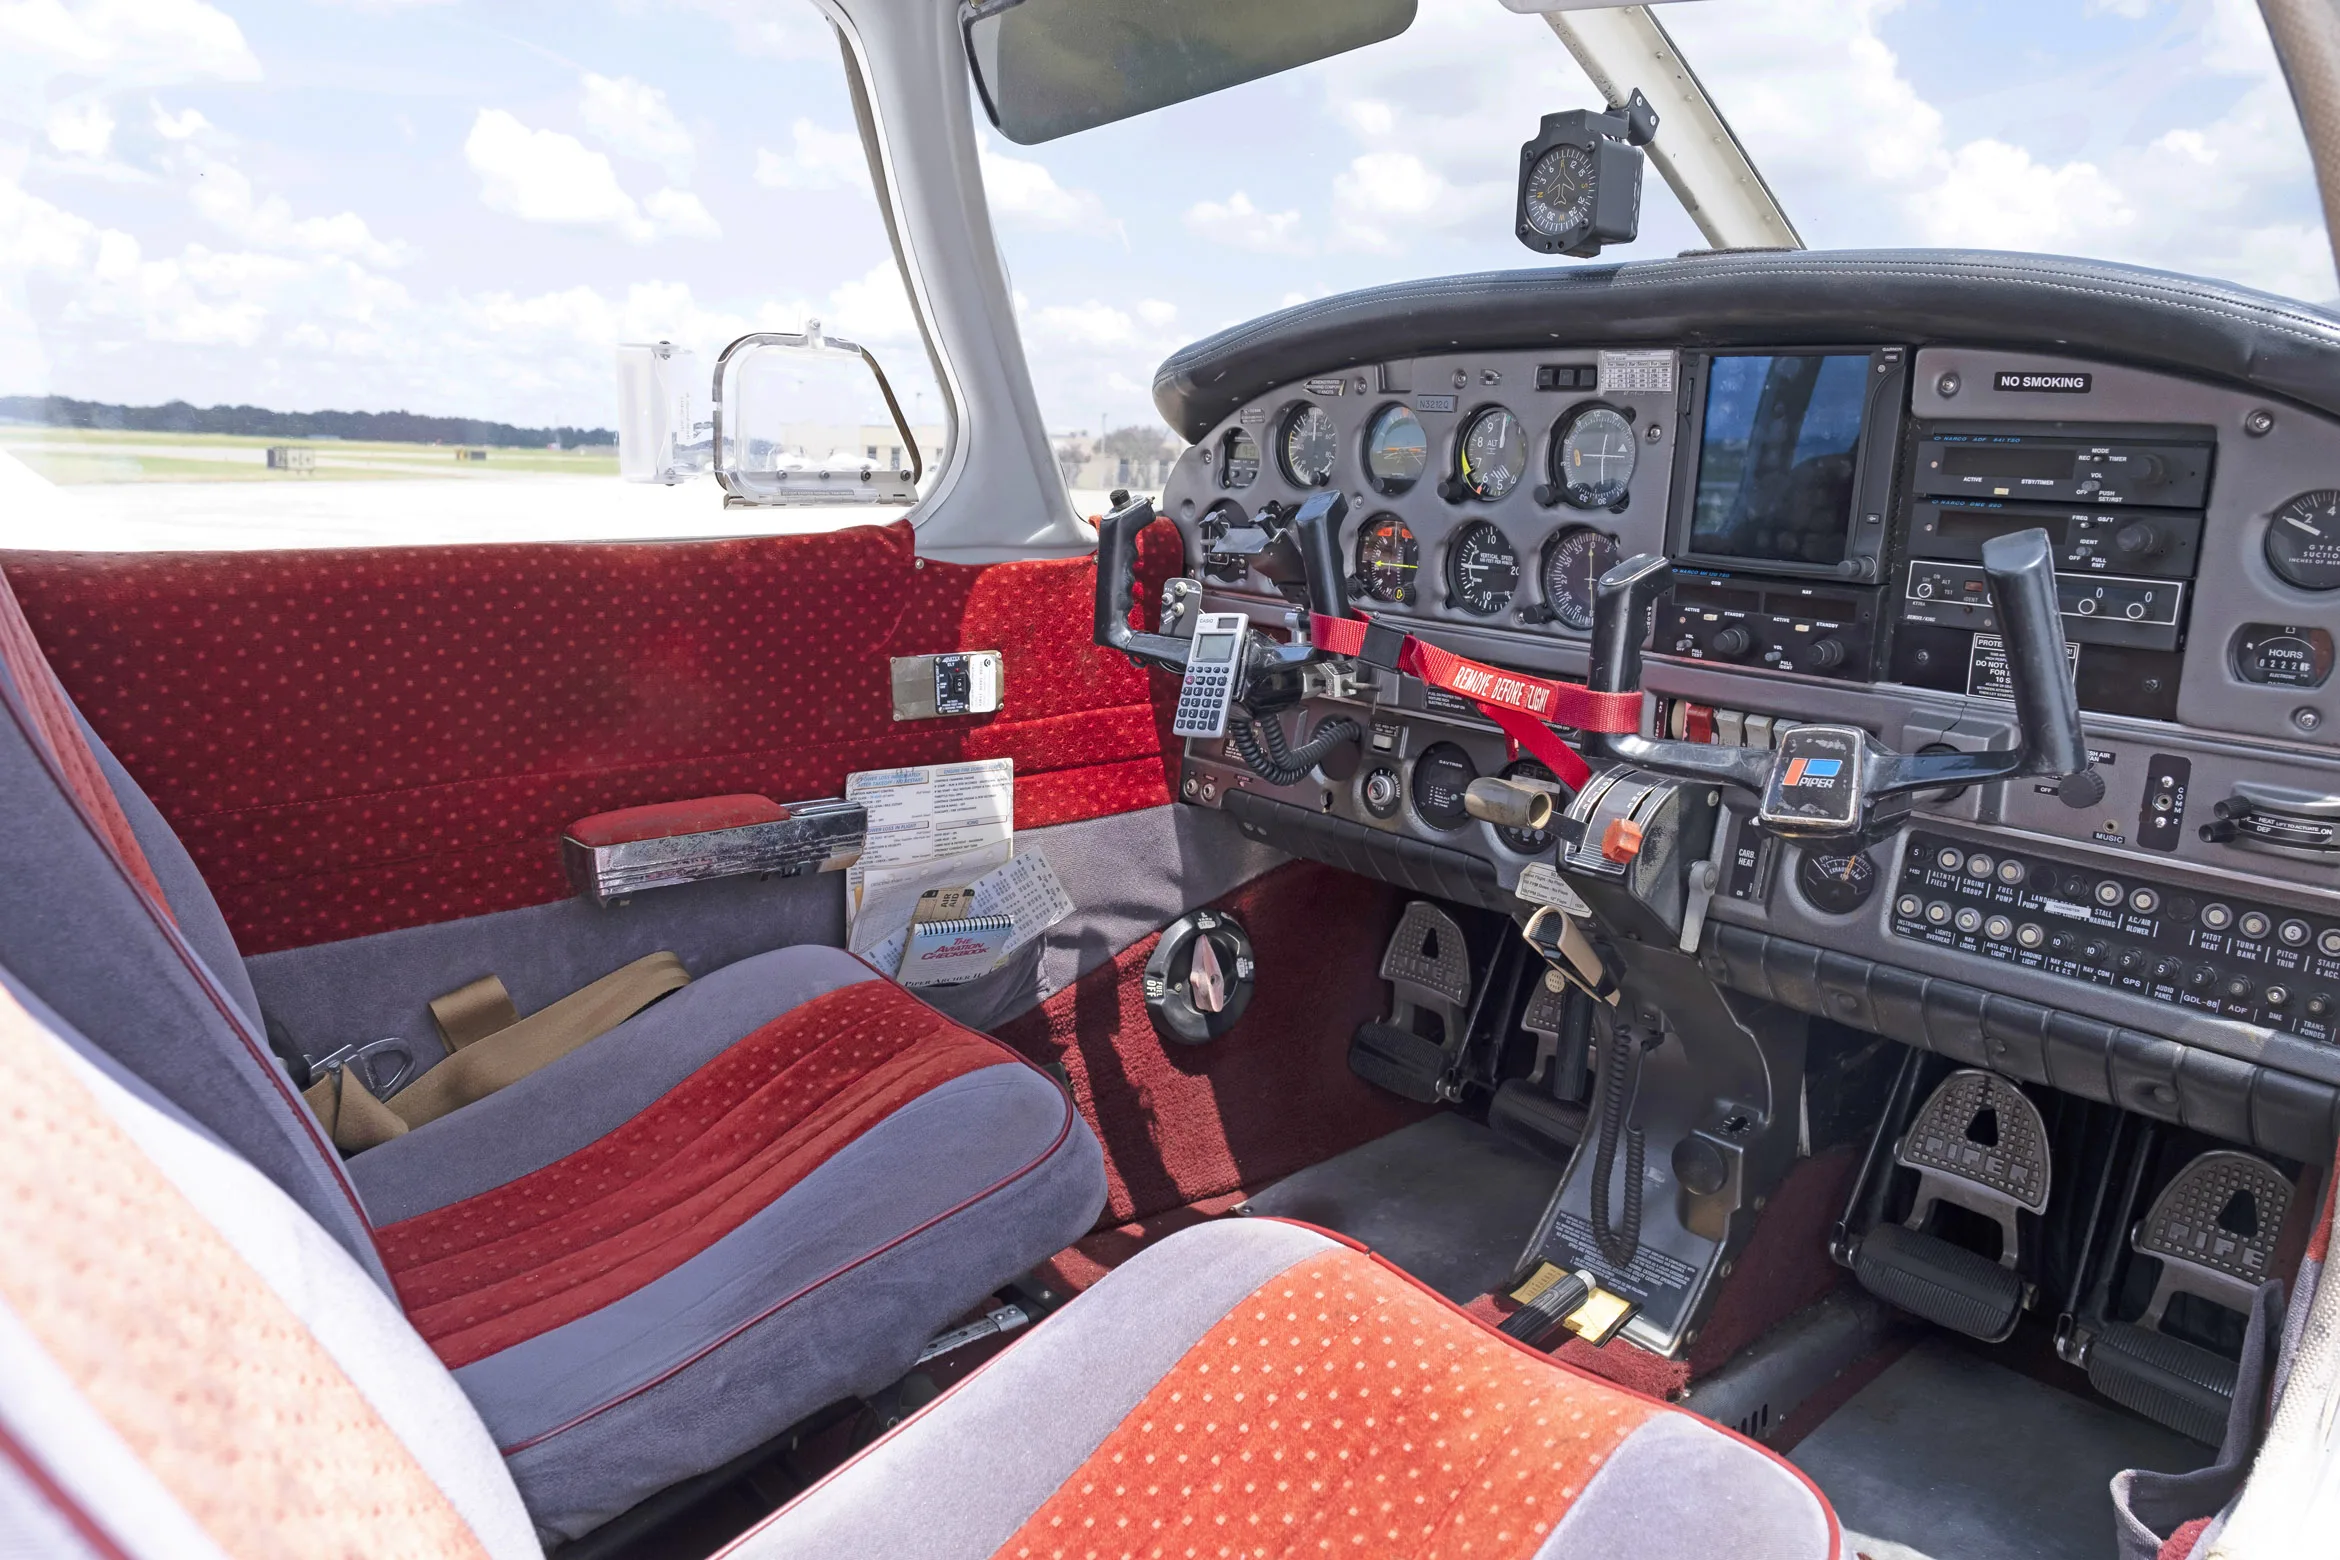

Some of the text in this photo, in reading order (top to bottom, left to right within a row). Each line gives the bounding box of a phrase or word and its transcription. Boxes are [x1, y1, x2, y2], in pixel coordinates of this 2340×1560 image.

[2001, 376, 2084, 388] NO SMOKING
[1419, 401, 1449, 410] N3212Q
[1487, 422, 1494, 432] 9
[1477, 437, 1484, 447] 8
[1487, 439, 1499, 447] ALT
[1476, 457, 1482, 468] 7
[1482, 472, 1489, 483] 6
[1497, 480, 1503, 490] 5
[2327, 506, 2336, 516] 4
[2304, 514, 2313, 524] 2
[1487, 534, 1497, 545] 10
[1590, 541, 1596, 550] 0
[1480, 552, 1513, 562] VERTICAL SPEED
[2303, 551, 2340, 559] SUCTIO
[1482, 591, 1492, 601] 10
[2096, 587, 2103, 599] 0
[2145, 591, 2152, 602] 0
[1978, 639, 2003, 648] PROTE
[2269, 649, 2303, 659] HOURS
[1988, 660, 2003, 669] NOT
[1990, 668, 2006, 677] FOR
[1453, 666, 1494, 697] REMOVE
[1491, 676, 1525, 706] BEFORE
[1799, 777, 1835, 789] PIPER
[2173, 786, 2184, 814] COMM
[2256, 825, 2271, 833] DEF
[2259, 817, 2275, 825] HEAT
[2295, 824, 2319, 832] ACTUATE
[2096, 832, 2123, 844] MUSIC
[1738, 848, 1756, 859] CARB.
[1913, 848, 1919, 856] 5
[1738, 857, 1754, 868] HEAT
[1930, 878, 1947, 888] FIELD
[1963, 878, 1985, 889] ENGINE
[1962, 886, 1983, 896] GROUP
[1997, 885, 2013, 895] FUEL
[941, 893, 952, 908] AIR
[950, 893, 960, 908] AID
[1995, 893, 2013, 903] PUMP
[2022, 901, 2038, 909] PUMP
[2094, 908, 2112, 918] STALL
[2089, 916, 2116, 928] WARNING
[1896, 926, 1910, 934] PANEL
[1897, 919, 1951, 938] INSTRUMENT LIGHTS
[2126, 924, 2149, 936] BLOWER
[2290, 929, 2297, 938] 5
[953, 937, 973, 946] THE
[1926, 933, 1950, 944] OVERHEAD
[2202, 932, 2222, 943] PITOT
[935, 943, 985, 954] AVIATION
[1960, 942, 1976, 951] LIGHTS
[2086, 946, 2095, 954] 10
[2201, 941, 2219, 951] HEAT
[2236, 940, 2256, 950] TURN
[921, 947, 990, 961] CHECKBOOK
[1991, 950, 2005, 958] LIGHT
[2020, 950, 2042, 960] LANDING
[2236, 949, 2257, 960] BANK
[2277, 949, 2298, 960] PITCH
[2021, 957, 2037, 966] LIGHT
[2123, 956, 2130, 965] 5
[2276, 958, 2295, 969] TRIM
[2317, 958, 2340, 969] START
[2157, 964, 2164, 973] 5
[2122, 977, 2141, 988] GPS
[2195, 973, 2202, 982] 3
[1146, 980, 1157, 997] OFF
[2155, 984, 2174, 994] AUDIO
[2154, 991, 2173, 1001] PANEL
[2183, 994, 2218, 1009] GDL-88
[2313, 1001, 2320, 1010] 3
[2227, 1003, 2248, 1014] ADF
[2268, 1011, 2283, 1022] DME
[1925, 1136, 2028, 1184] PIPER
[2168, 1222, 2265, 1270] PIPE
